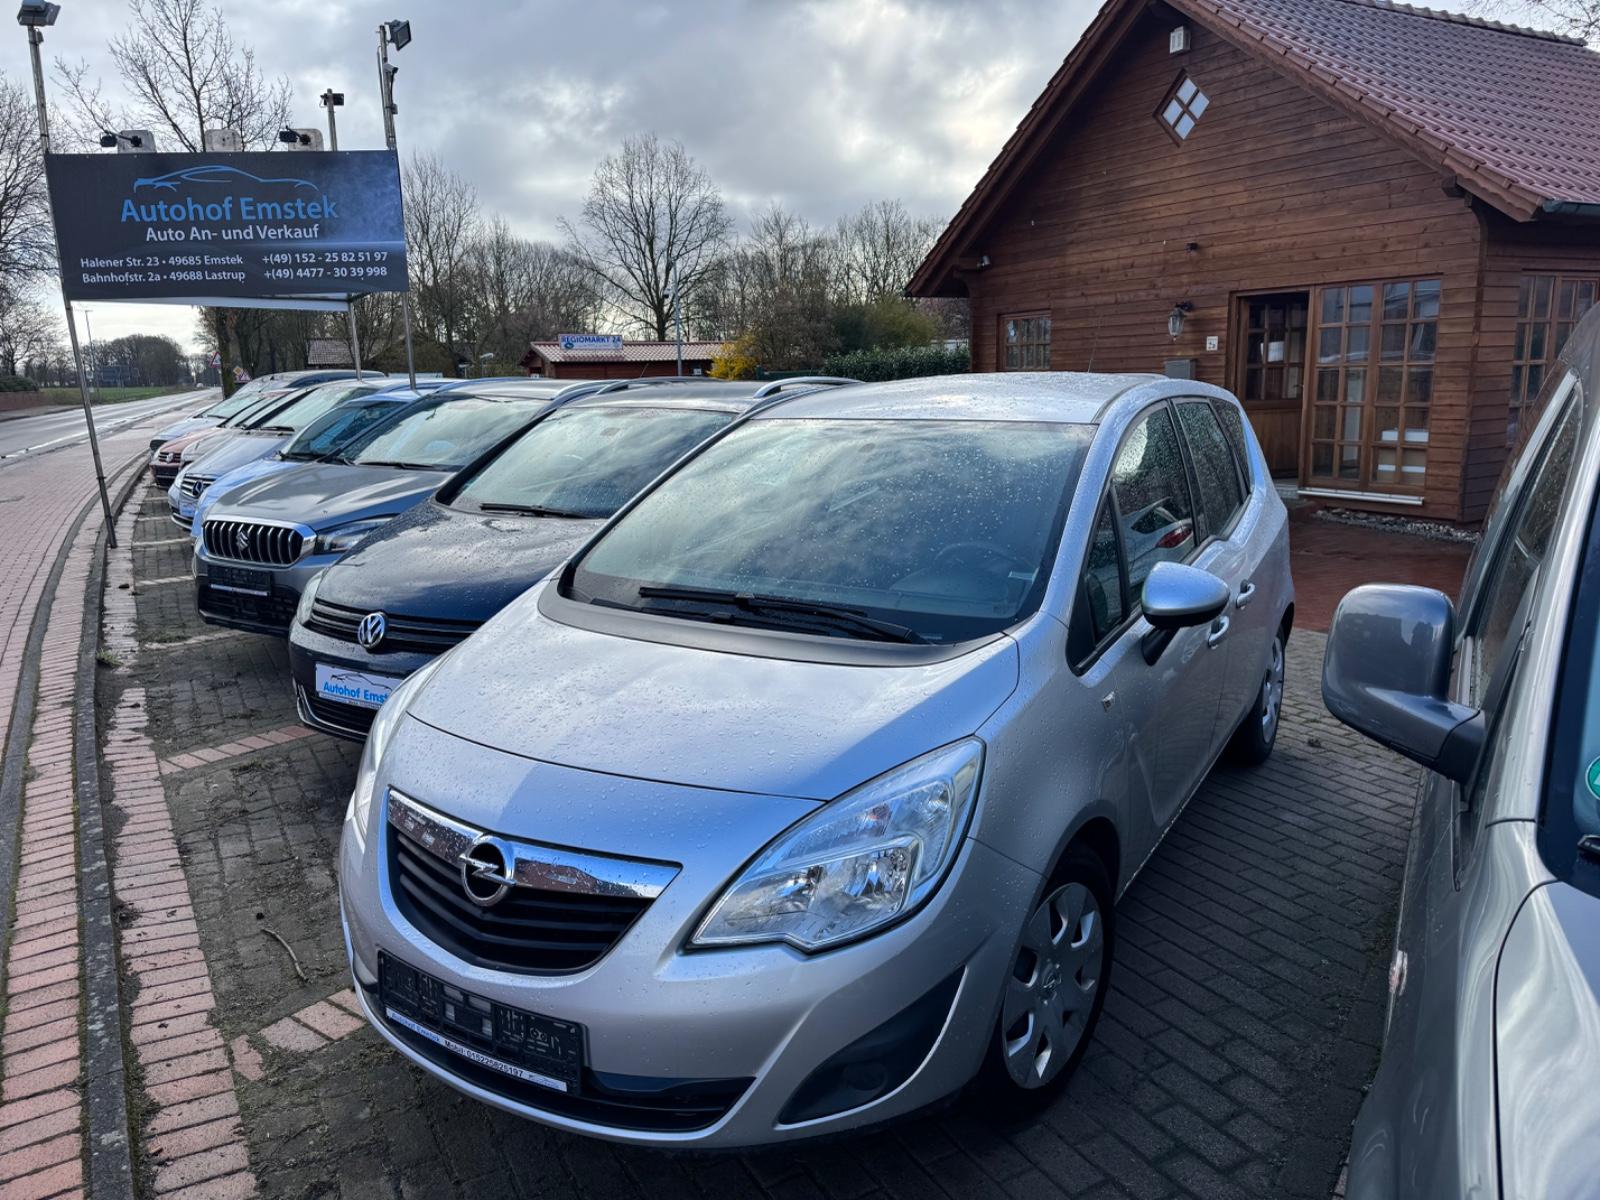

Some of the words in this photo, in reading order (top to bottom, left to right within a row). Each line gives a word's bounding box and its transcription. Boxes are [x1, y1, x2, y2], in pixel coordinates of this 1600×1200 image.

[121, 196, 232, 222] Autohof
[239, 195, 339, 221] Emstek
[146, 227, 185, 242] Auto
[189, 226, 218, 241] An-
[222, 225, 254, 240] und
[256, 224, 320, 240] Verkauf
[80, 257, 123, 268] Halener
[126, 257, 144, 267] Str.
[146, 257, 160, 267] 23
[168, 255, 201, 266] 49685
[204, 255, 243, 265] Emstek
[262, 253, 292, 265] +(49)
[295, 253, 316, 263] 152
[325, 252, 339, 262] 25
[341, 252, 356, 262] 82
[358, 252, 371, 262] 51
[374, 251, 388, 262] 97
[82, 271, 146, 283] Bahnhofstr.
[148, 271, 161, 282] 2a
[169, 270, 203, 281] 49688
[205, 270, 246, 282] Lastrup
[264, 268, 294, 280] +(49)
[296, 268, 324, 278] 4477
[333, 267, 348, 277] 30
[350, 267, 364, 277] 39
[366, 266, 388, 276] 998
[561, 335, 610, 343] REGIOMARKT
[323, 681, 360, 698] Autohof
[363, 689, 389, 704] Emst
